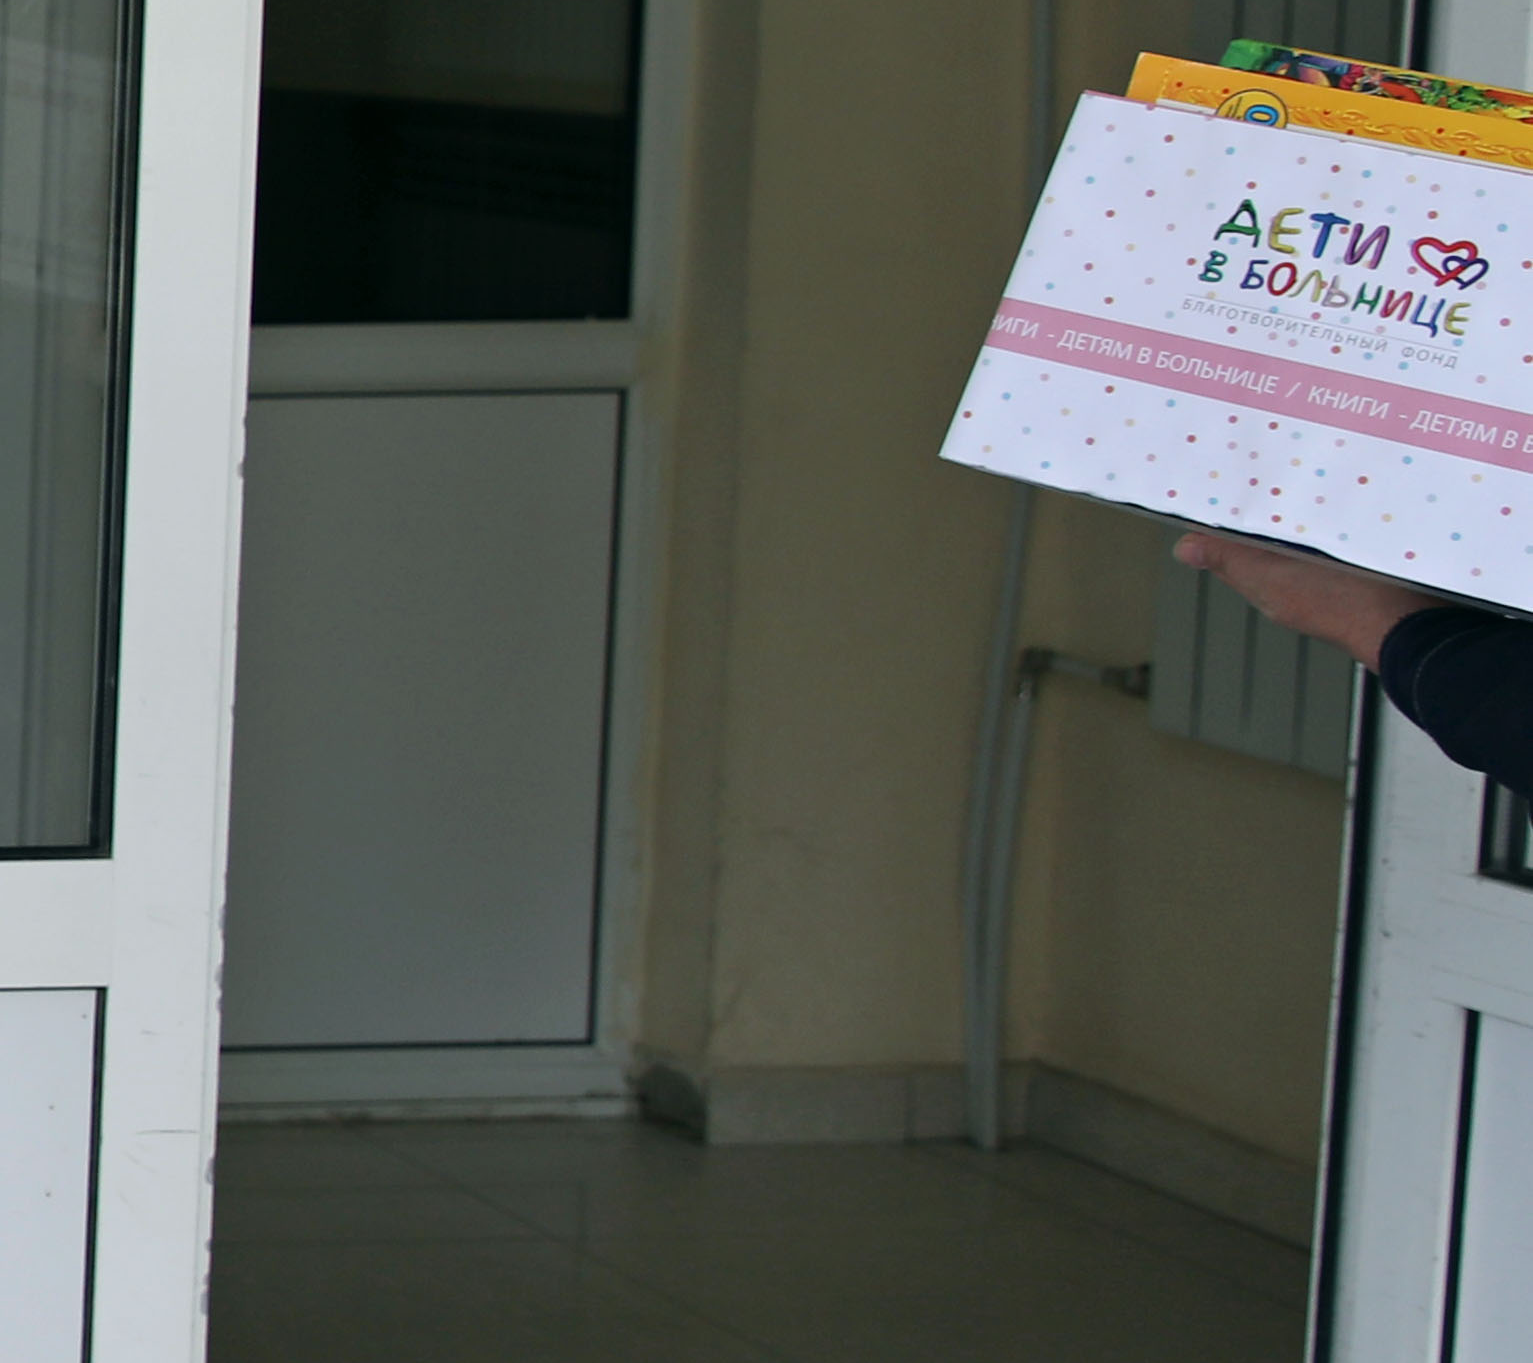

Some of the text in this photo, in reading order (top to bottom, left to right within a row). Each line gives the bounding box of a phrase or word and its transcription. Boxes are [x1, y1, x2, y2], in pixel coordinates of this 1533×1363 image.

[1213, 199, 1391, 270] ДЕТИ
[1182, 298, 1459, 370] БЛАГОТВОРИТЕЛЬНЫЙ ФОНД
[1240, 259, 1472, 338] БОЛЬНИЦЕ
[1056, 330, 1133, 361] ДЕТЯМ
[1136, 347, 1153, 365] В
[1155, 351, 1280, 395] БОЛЬНИЦЕ
[1306, 385, 1391, 420] КНИГИ
[1408, 410, 1498, 445] ДЕТЯМ
[1501, 429, 1519, 449] В
